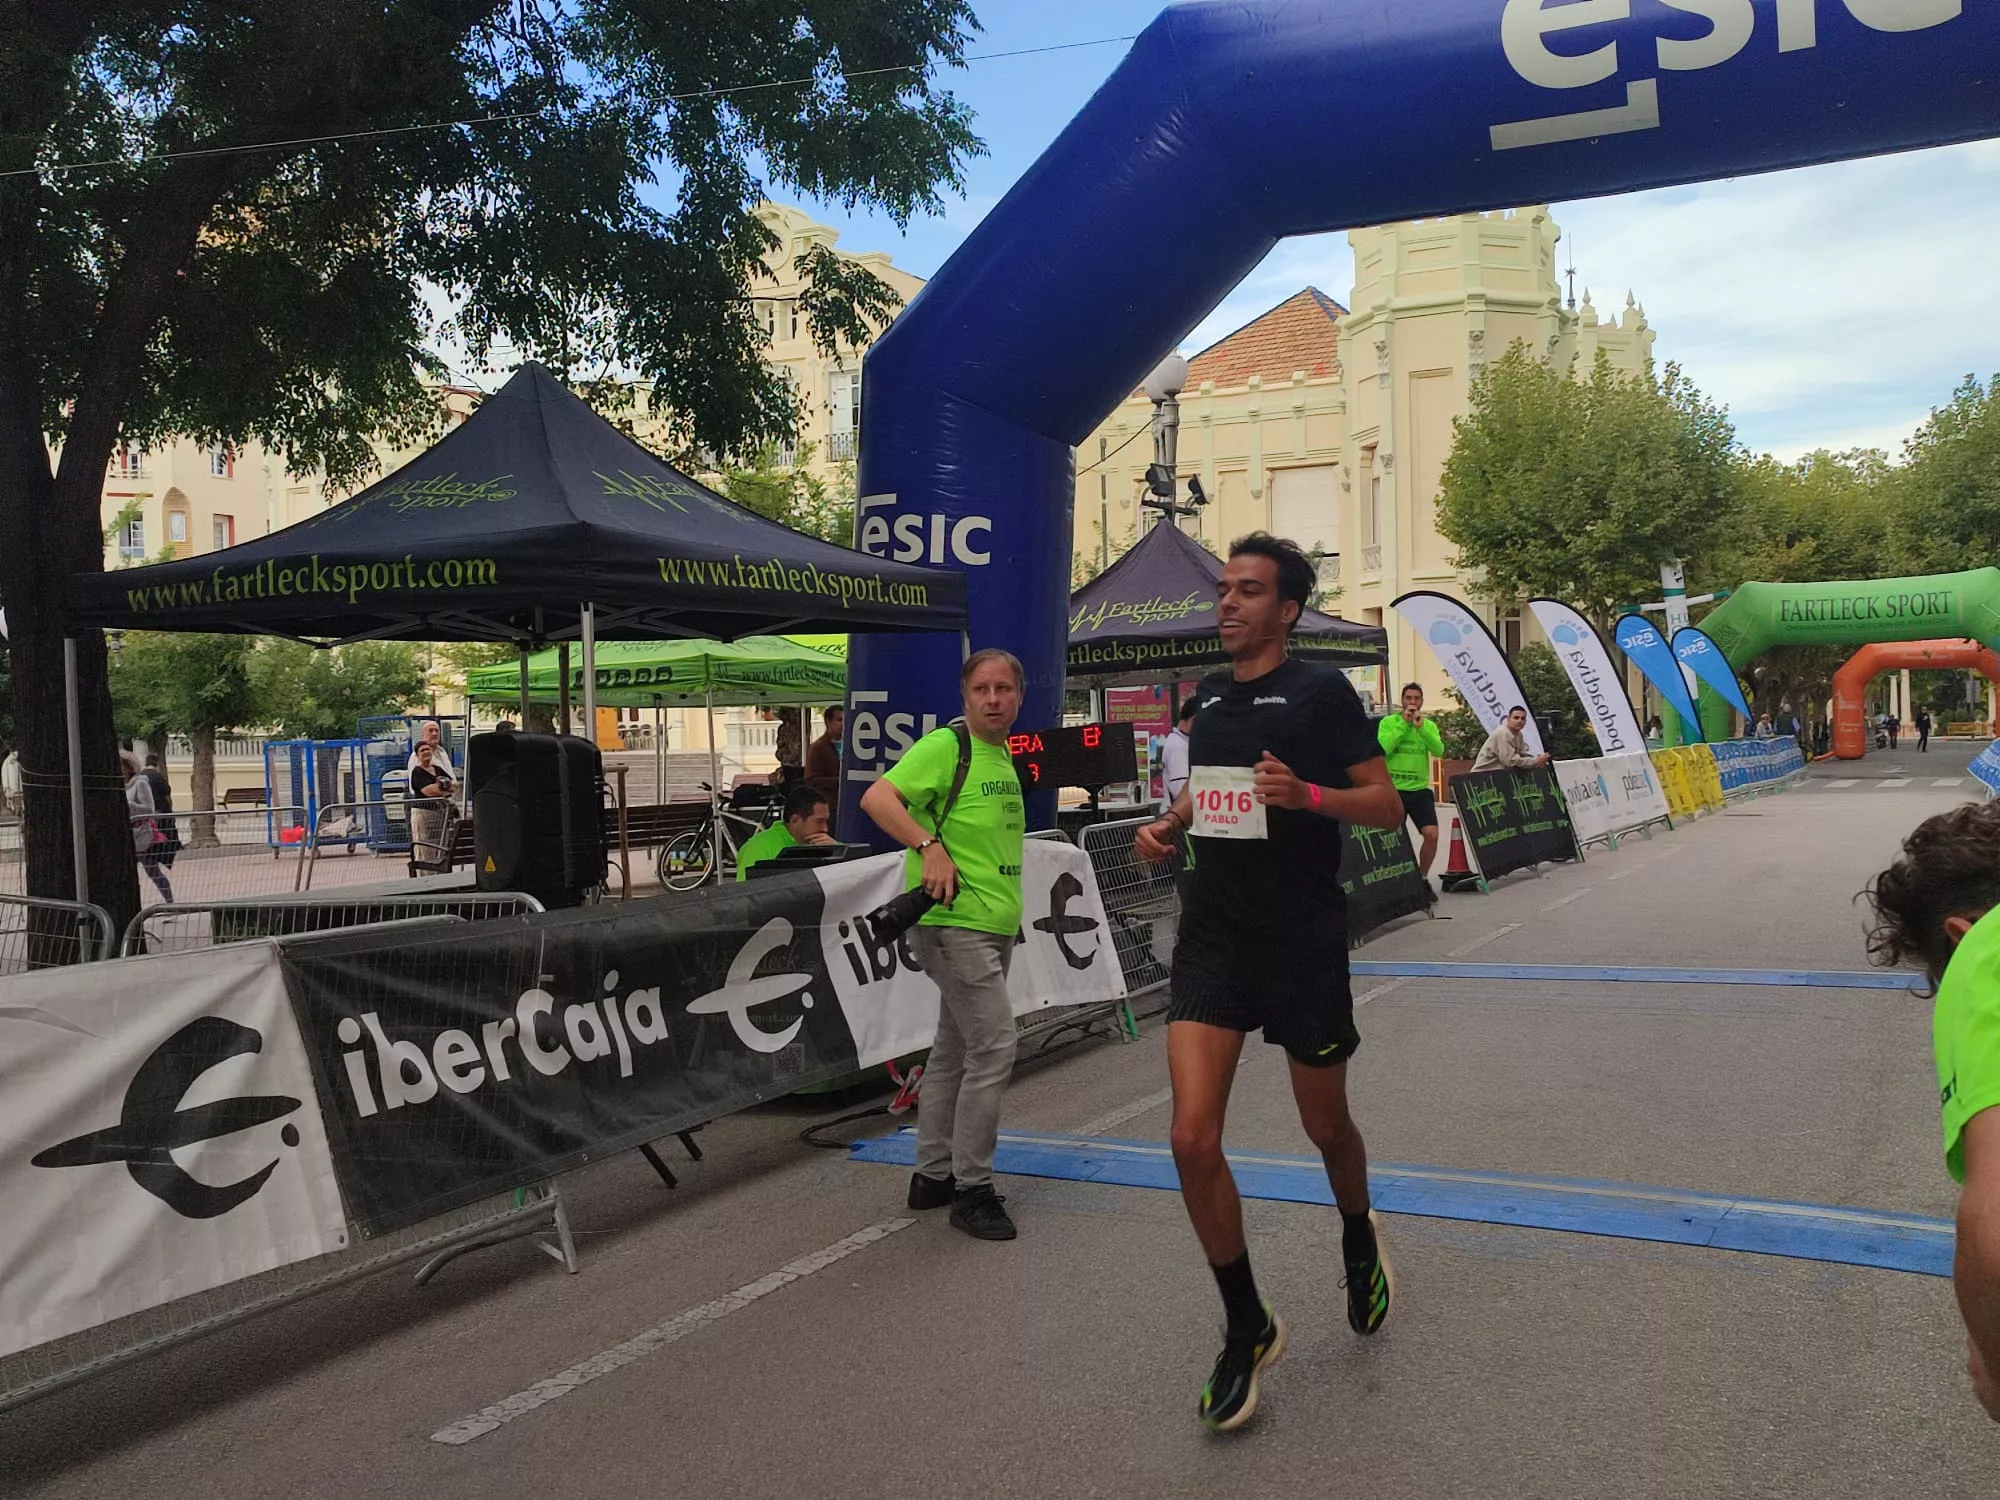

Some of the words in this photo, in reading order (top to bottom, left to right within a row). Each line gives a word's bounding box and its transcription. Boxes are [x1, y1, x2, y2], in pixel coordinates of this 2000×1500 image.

[127, 554, 499, 612] www.fartlecksport.com
[657, 554, 929, 607] www.fartlecksport.com
[1109, 591, 1201, 615] Fartleck
[1781, 597, 1881, 622] FARTLECK
[1886, 591, 1953, 618] SPORT
[1129, 610, 1190, 627] Sport
[1196, 789, 1253, 814] 1016
[1204, 813, 1239, 825] PABLO
[337, 968, 669, 1118] iberCaja
